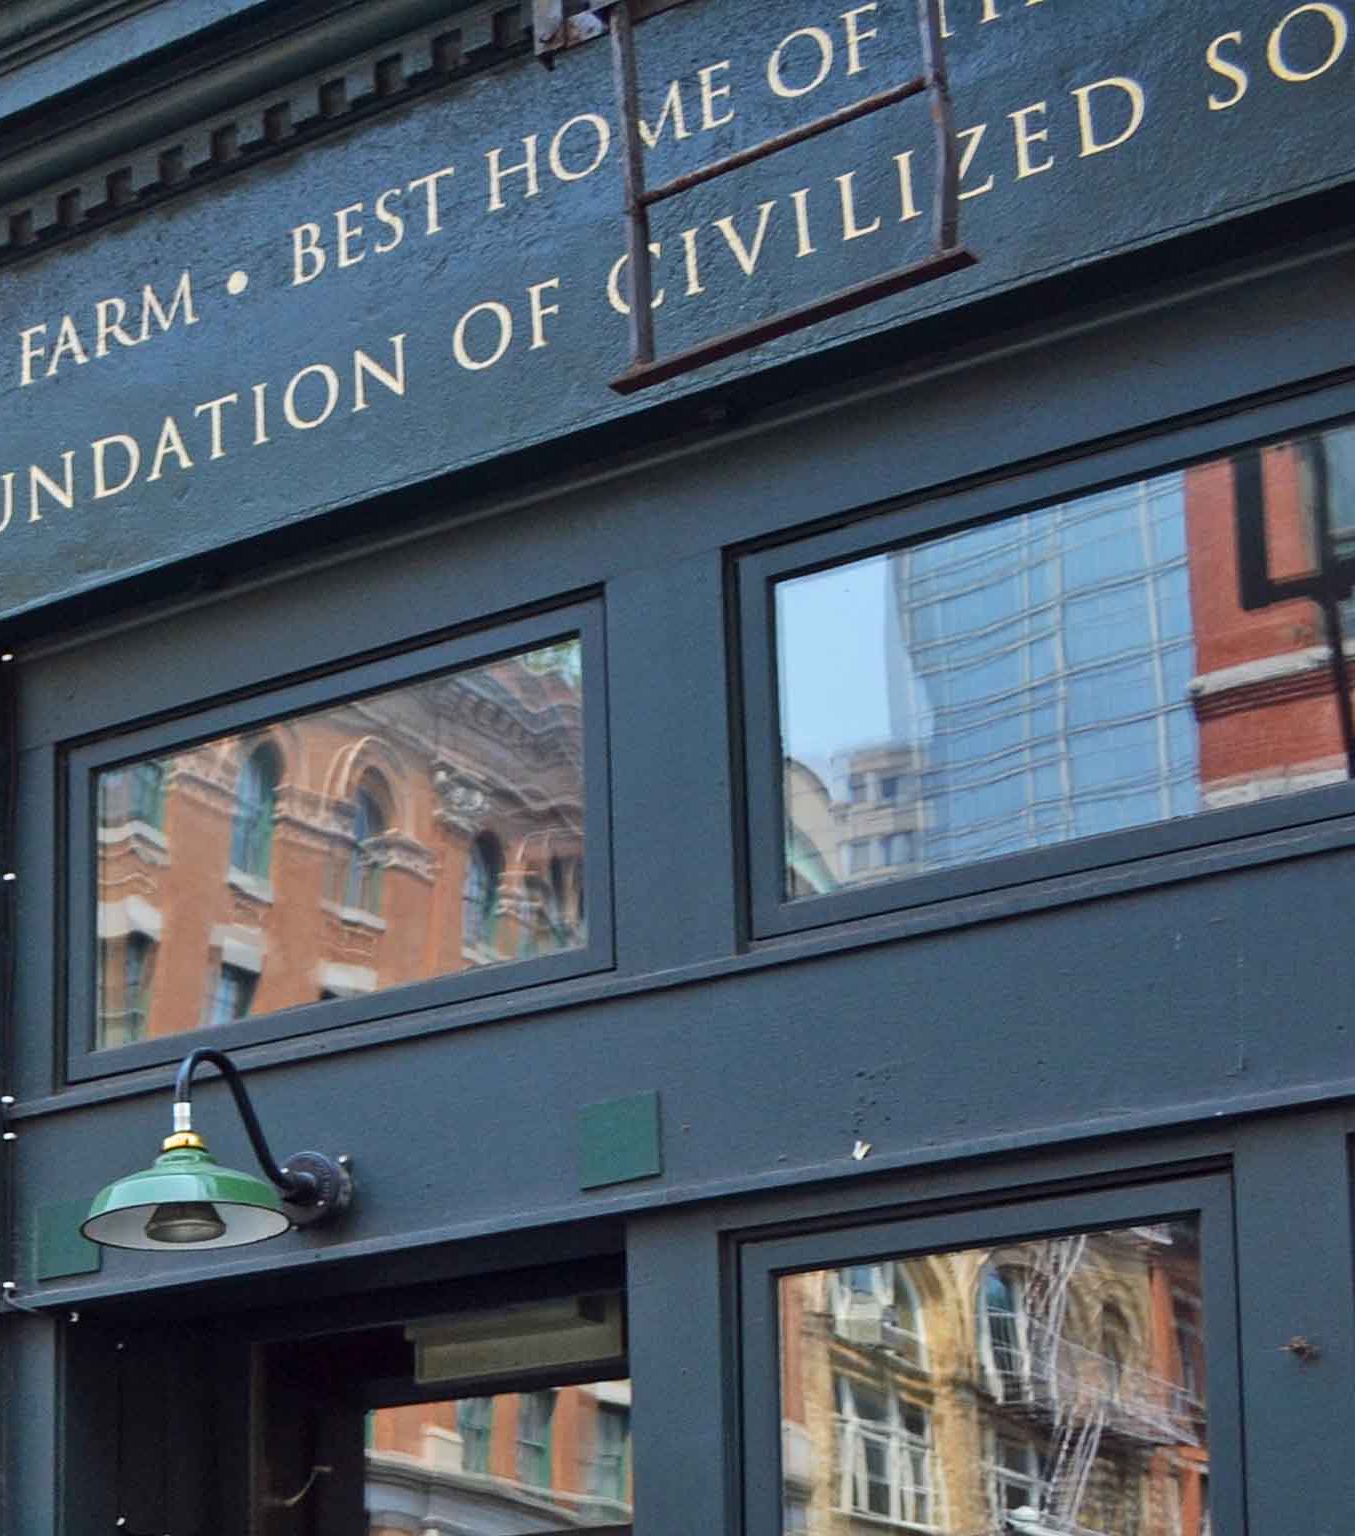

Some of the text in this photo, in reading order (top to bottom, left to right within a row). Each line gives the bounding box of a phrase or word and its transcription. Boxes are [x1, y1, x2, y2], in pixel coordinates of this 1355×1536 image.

[18, 269, 199, 388] FARM
[290, 167, 455, 287] BEST
[484, 60, 737, 213] HOME
[765, 3, 879, 98] OF
[451, 277, 561, 371] OF
[606, 76, 1146, 316] CIVILIZED
